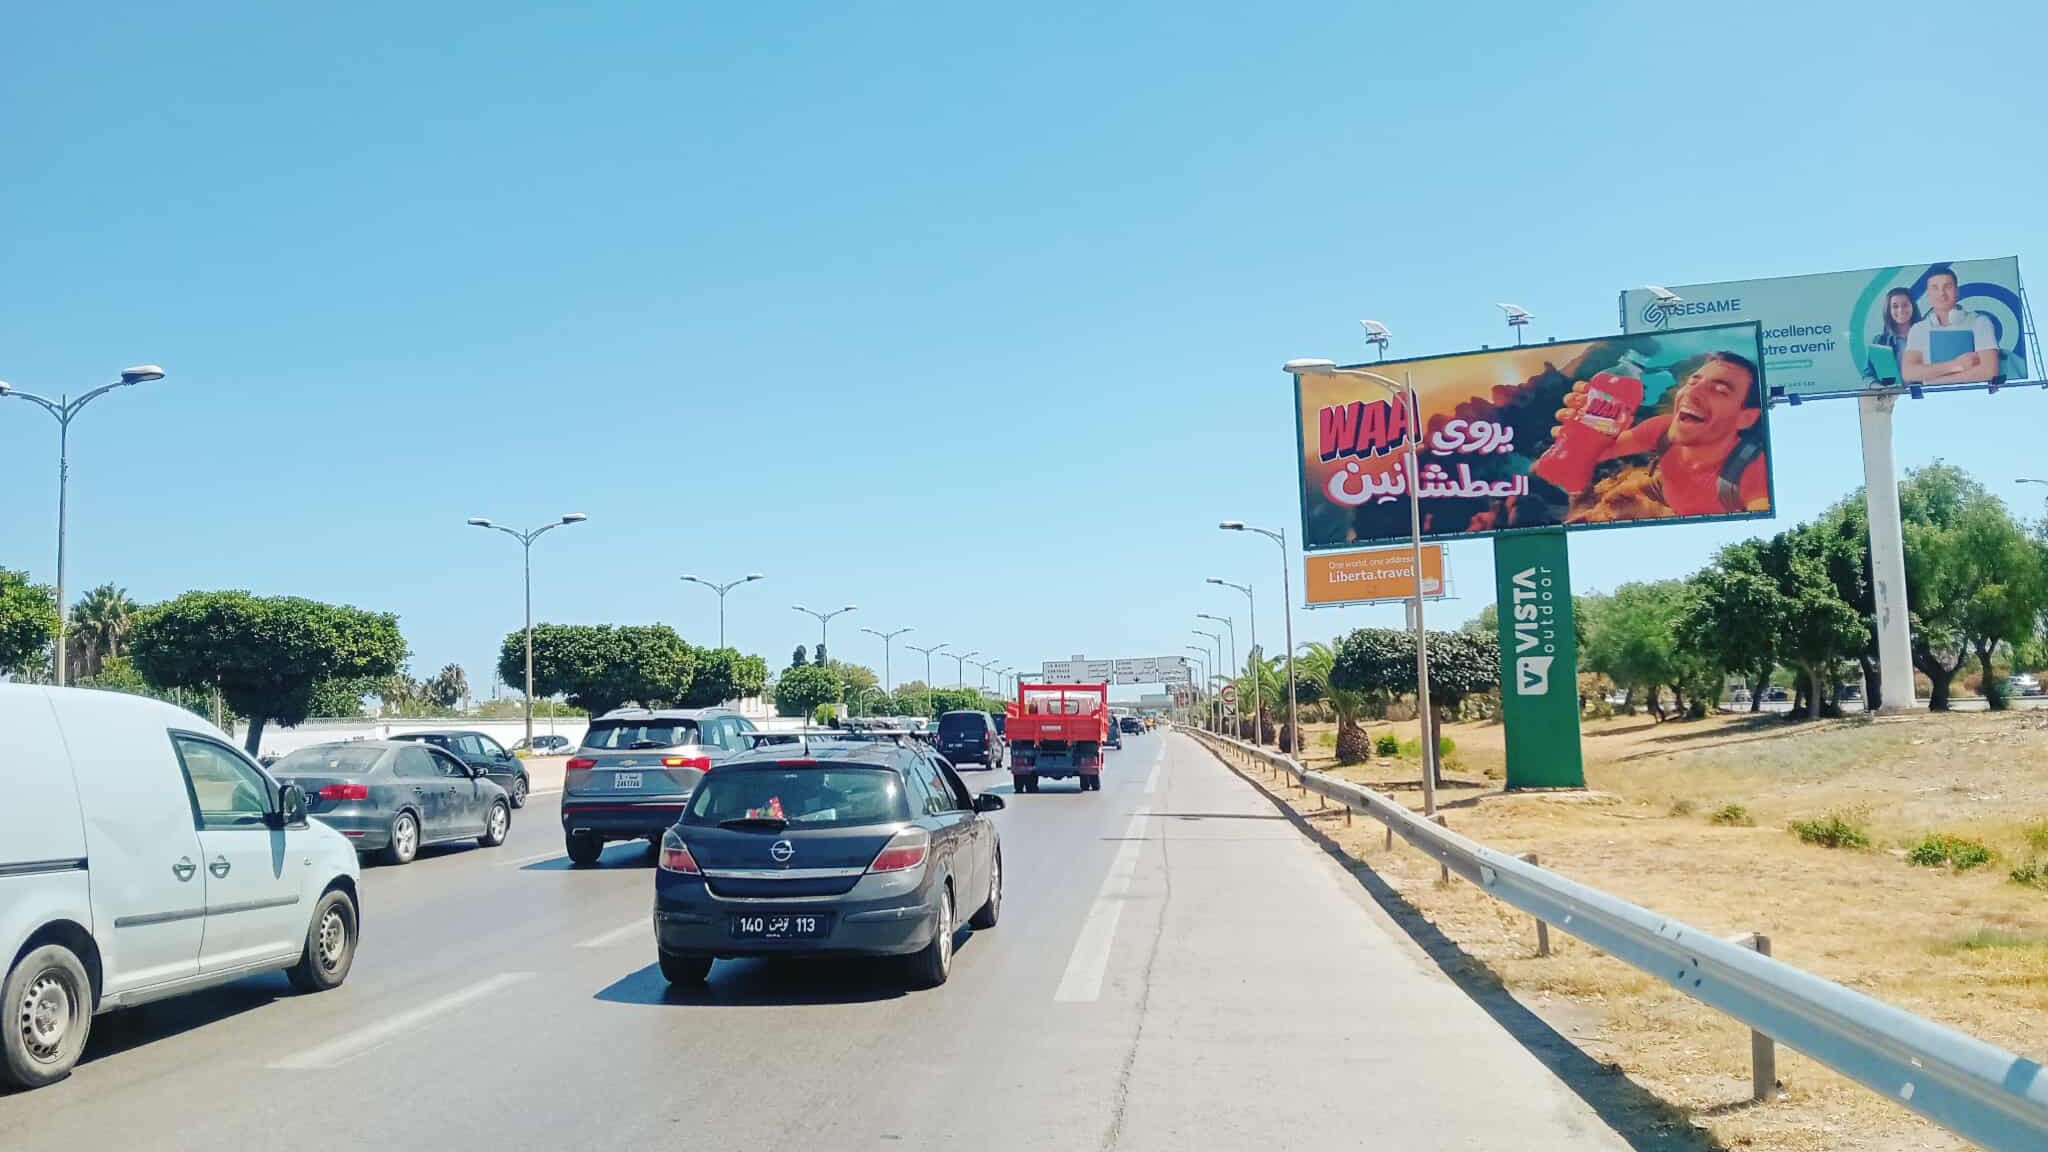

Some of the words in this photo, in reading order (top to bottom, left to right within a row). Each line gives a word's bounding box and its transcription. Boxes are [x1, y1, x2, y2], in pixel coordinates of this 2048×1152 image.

[1790, 339, 1835, 353] avenir
[1431, 419, 1514, 457] يروي
[1326, 451, 1529, 506] العطشانين
[1328, 565, 1415, 583] Liberta.travel
[1512, 566, 1539, 654] VISTA
[1537, 565, 1555, 654] outdoor
[740, 917, 763, 932] 140
[796, 917, 815, 932] 113
